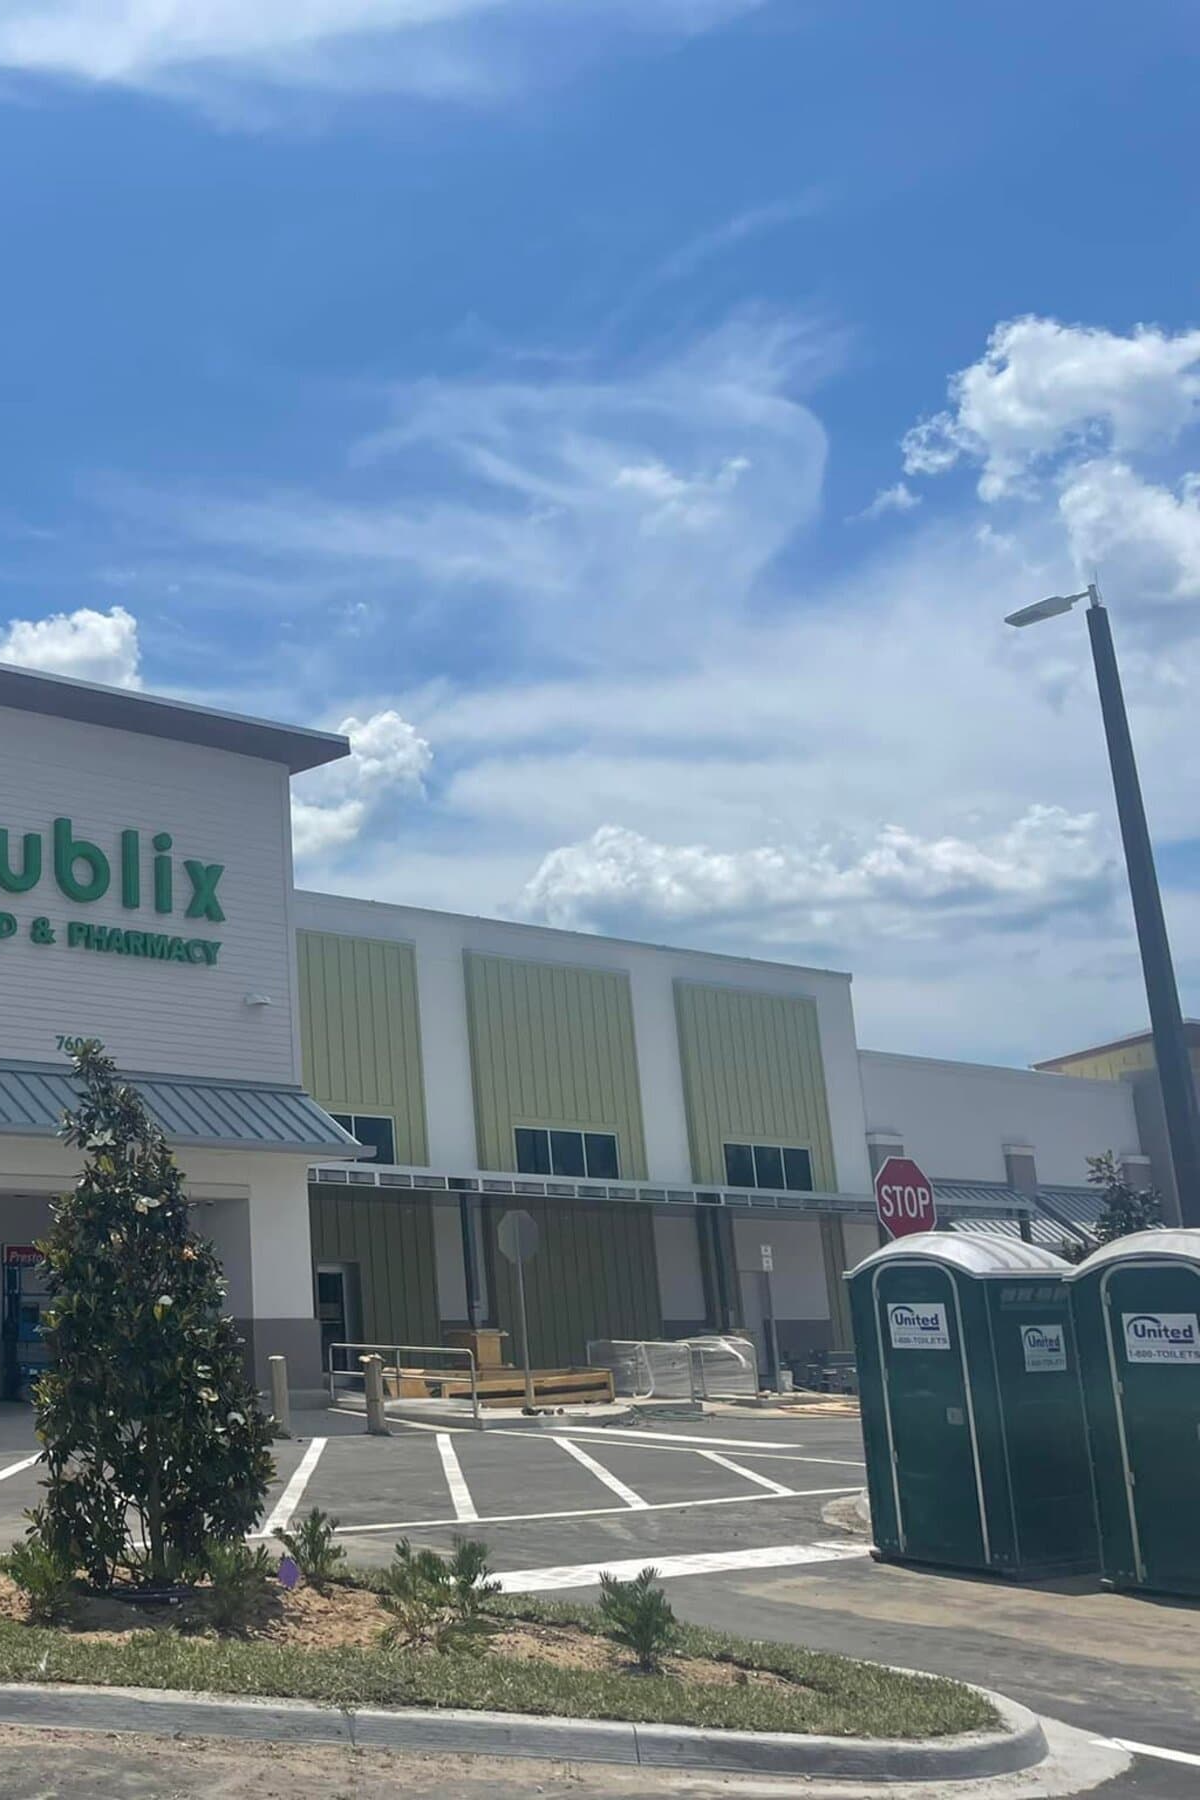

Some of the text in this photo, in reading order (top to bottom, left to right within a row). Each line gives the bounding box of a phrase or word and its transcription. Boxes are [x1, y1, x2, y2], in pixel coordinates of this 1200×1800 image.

[30, 916, 56, 944] &
[67, 921, 223, 966] PHARMACY
[881, 1185, 930, 1218] STOP
[895, 1313, 939, 1326] United
[1133, 1323, 1193, 1338] United
[1028, 1334, 1060, 1348] United
